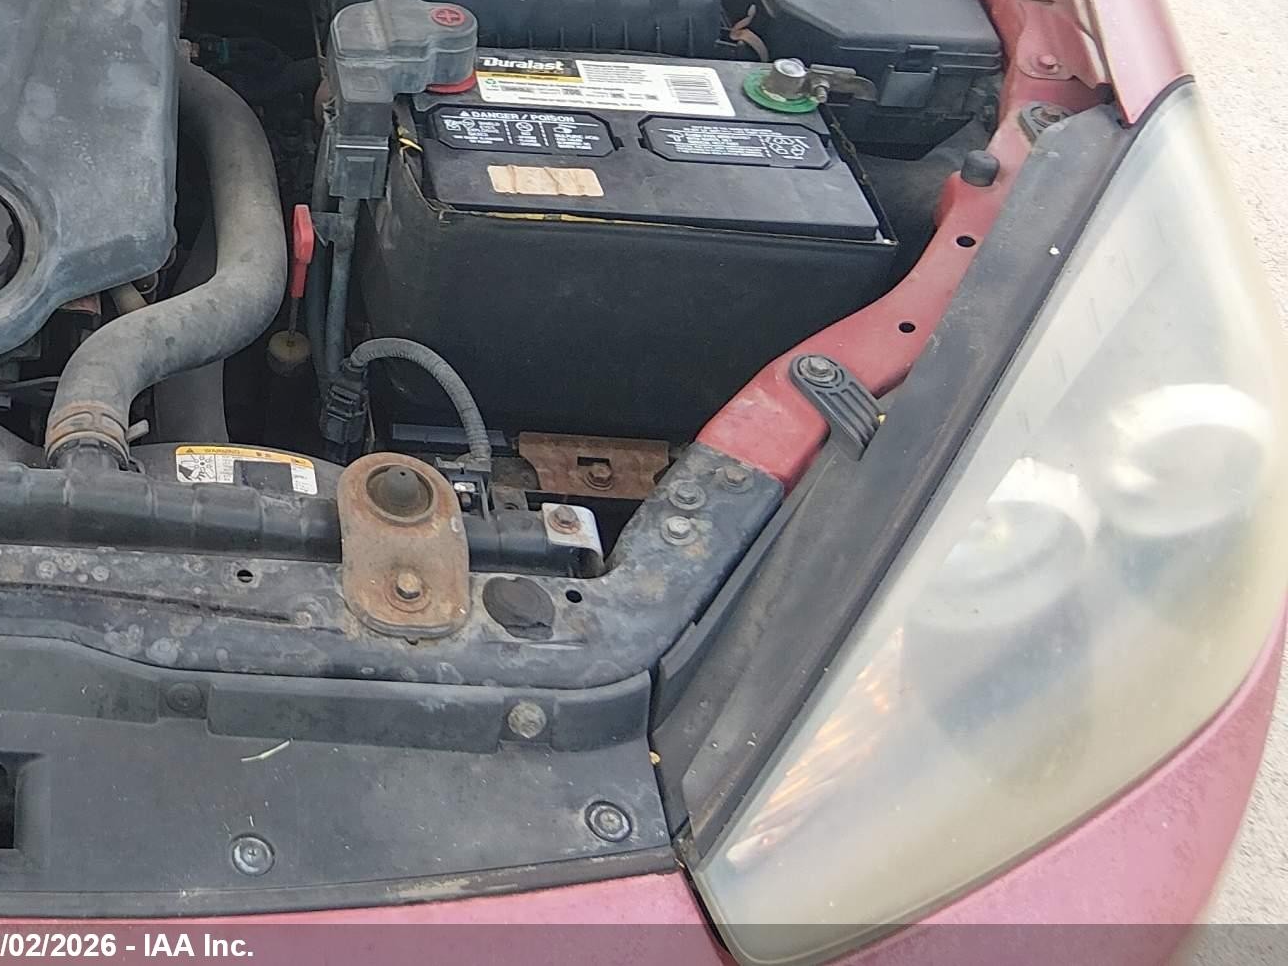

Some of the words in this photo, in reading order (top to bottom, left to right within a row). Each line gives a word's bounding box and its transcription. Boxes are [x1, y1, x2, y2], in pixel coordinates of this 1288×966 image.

[478, 56, 565, 72] Duralast
[471, 111, 520, 121] DANGER
[531, 113, 575, 124] POISON
